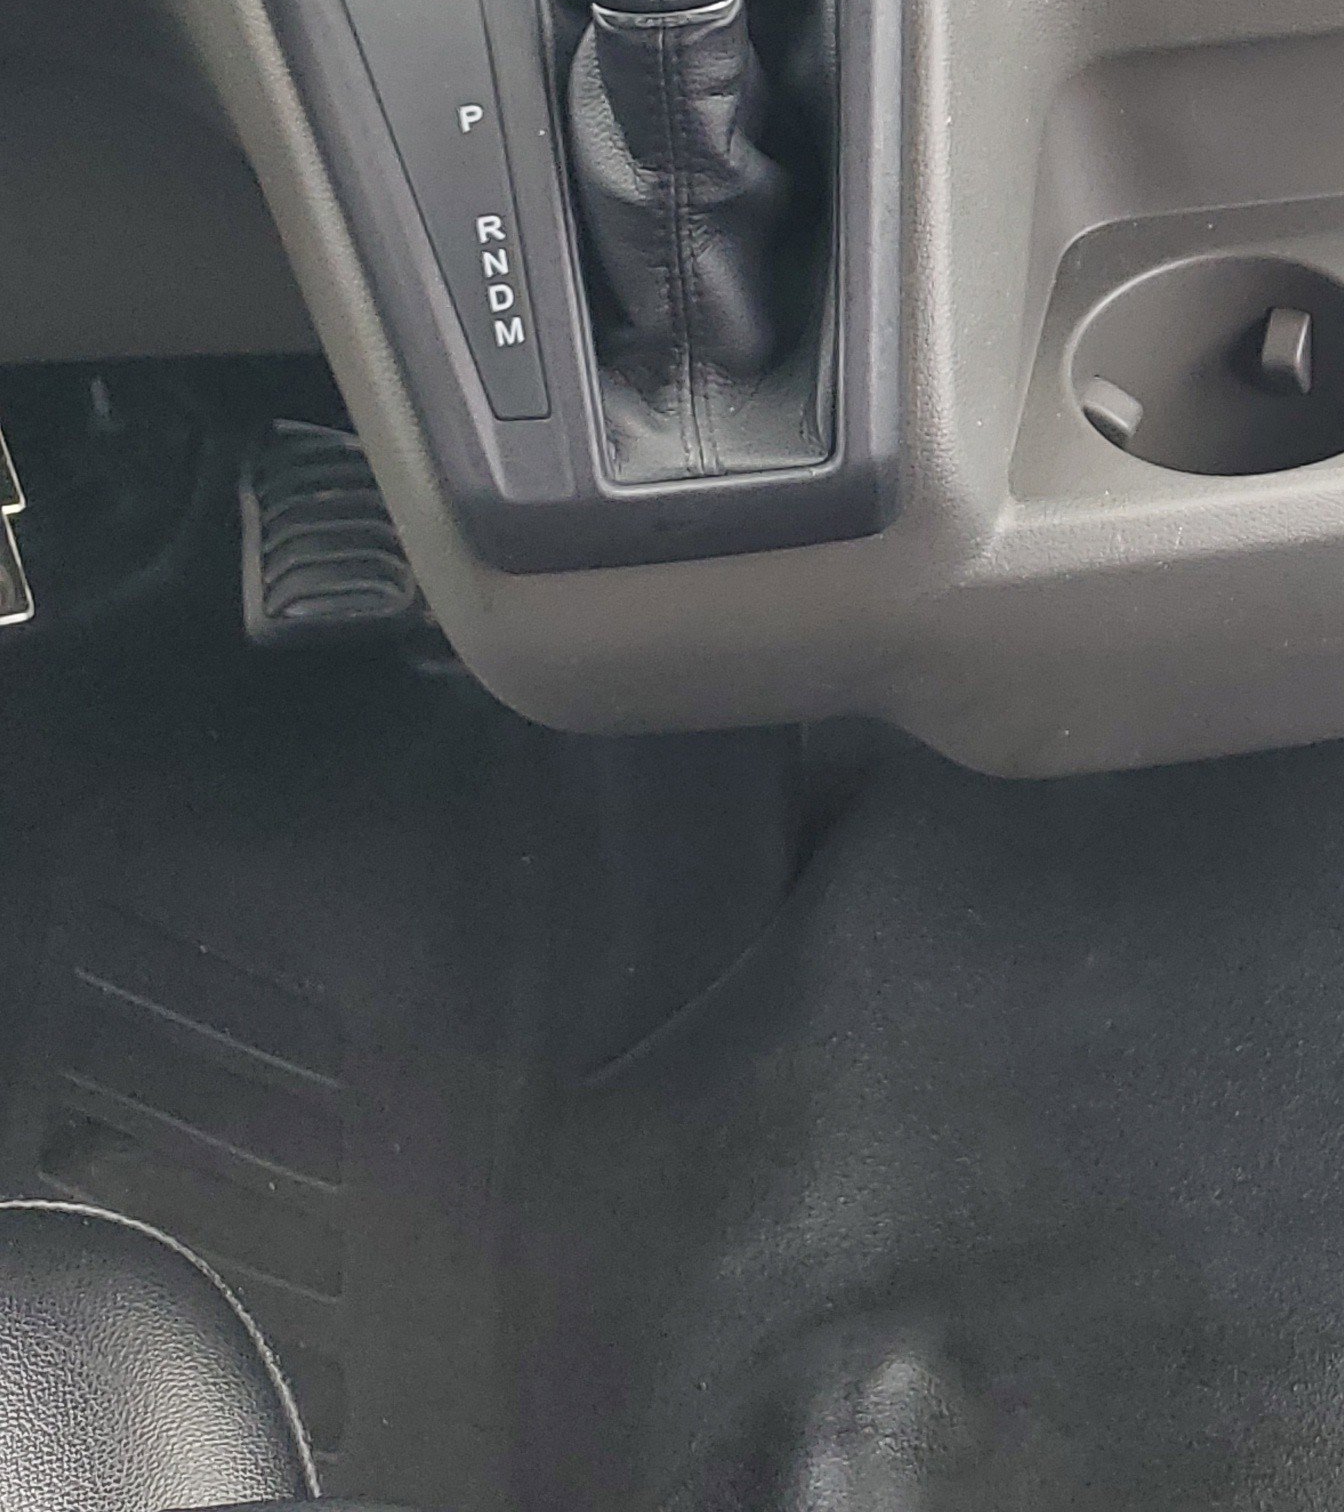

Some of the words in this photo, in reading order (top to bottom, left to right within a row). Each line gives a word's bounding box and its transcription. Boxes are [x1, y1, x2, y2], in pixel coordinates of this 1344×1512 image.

[458, 105, 484, 133] P
[476, 215, 506, 244] R
[483, 249, 508, 277] N
[488, 284, 514, 313] D
[494, 317, 525, 347] M
